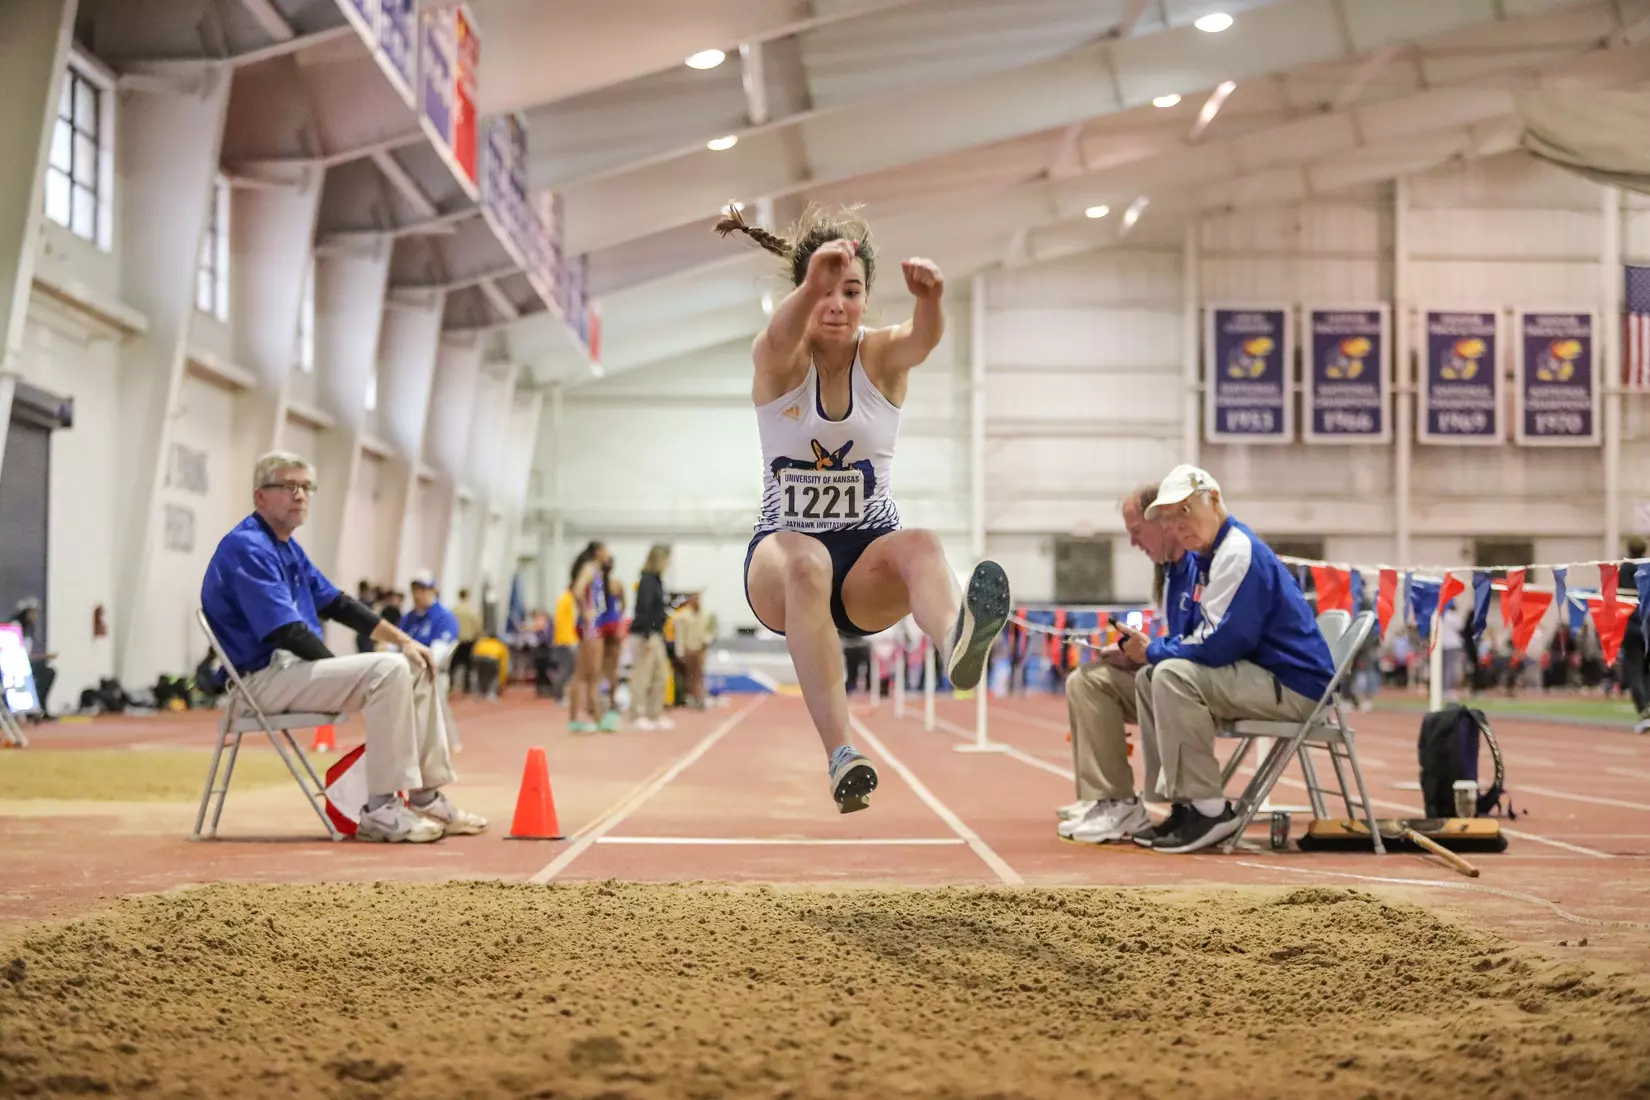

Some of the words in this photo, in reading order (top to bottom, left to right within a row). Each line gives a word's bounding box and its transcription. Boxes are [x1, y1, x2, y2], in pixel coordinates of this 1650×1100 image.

[785, 474, 821, 484] UNIVERSITY
[823, 476, 831, 484] OF
[833, 475, 859, 484] KANSAS
[785, 486, 859, 518] 1221
[785, 521, 815, 529] JAYHAWK
